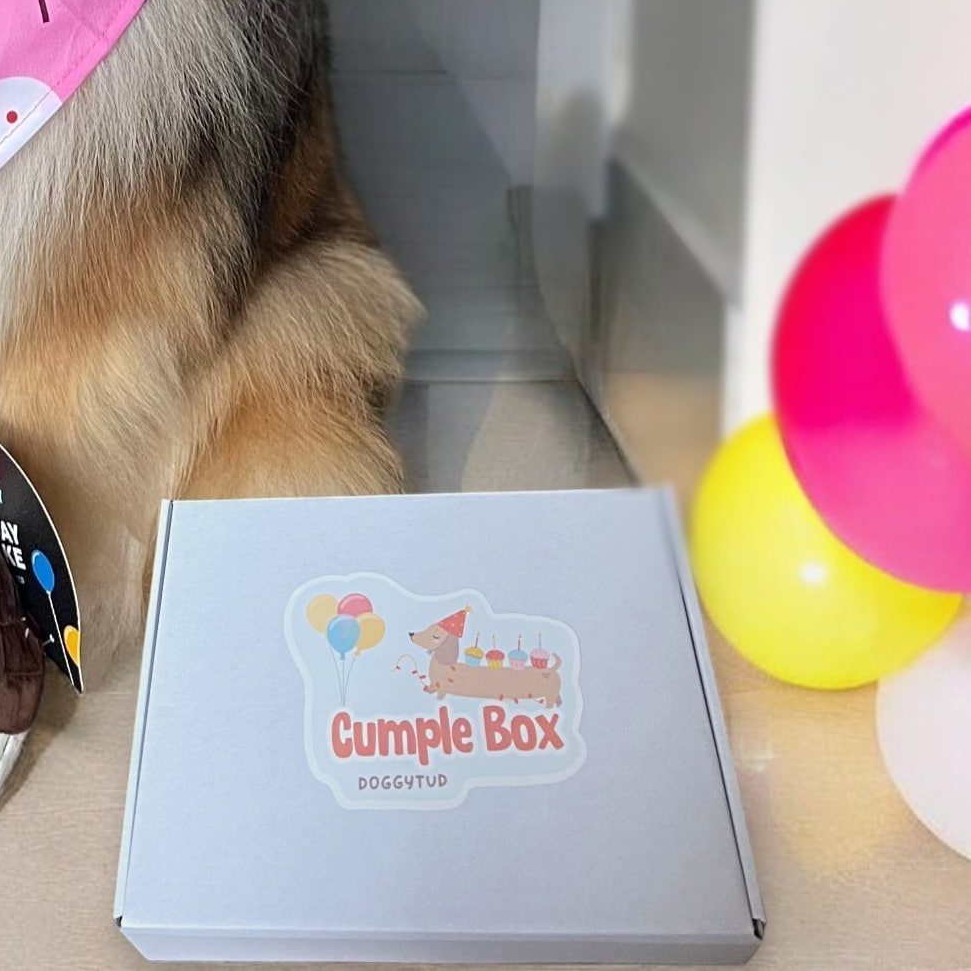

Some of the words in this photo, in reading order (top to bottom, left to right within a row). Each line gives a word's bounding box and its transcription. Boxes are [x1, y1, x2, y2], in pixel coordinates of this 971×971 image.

[331, 705, 474, 766] Cumple
[482, 705, 565, 752] Box
[358, 773, 448, 790] DOGGYTUD
